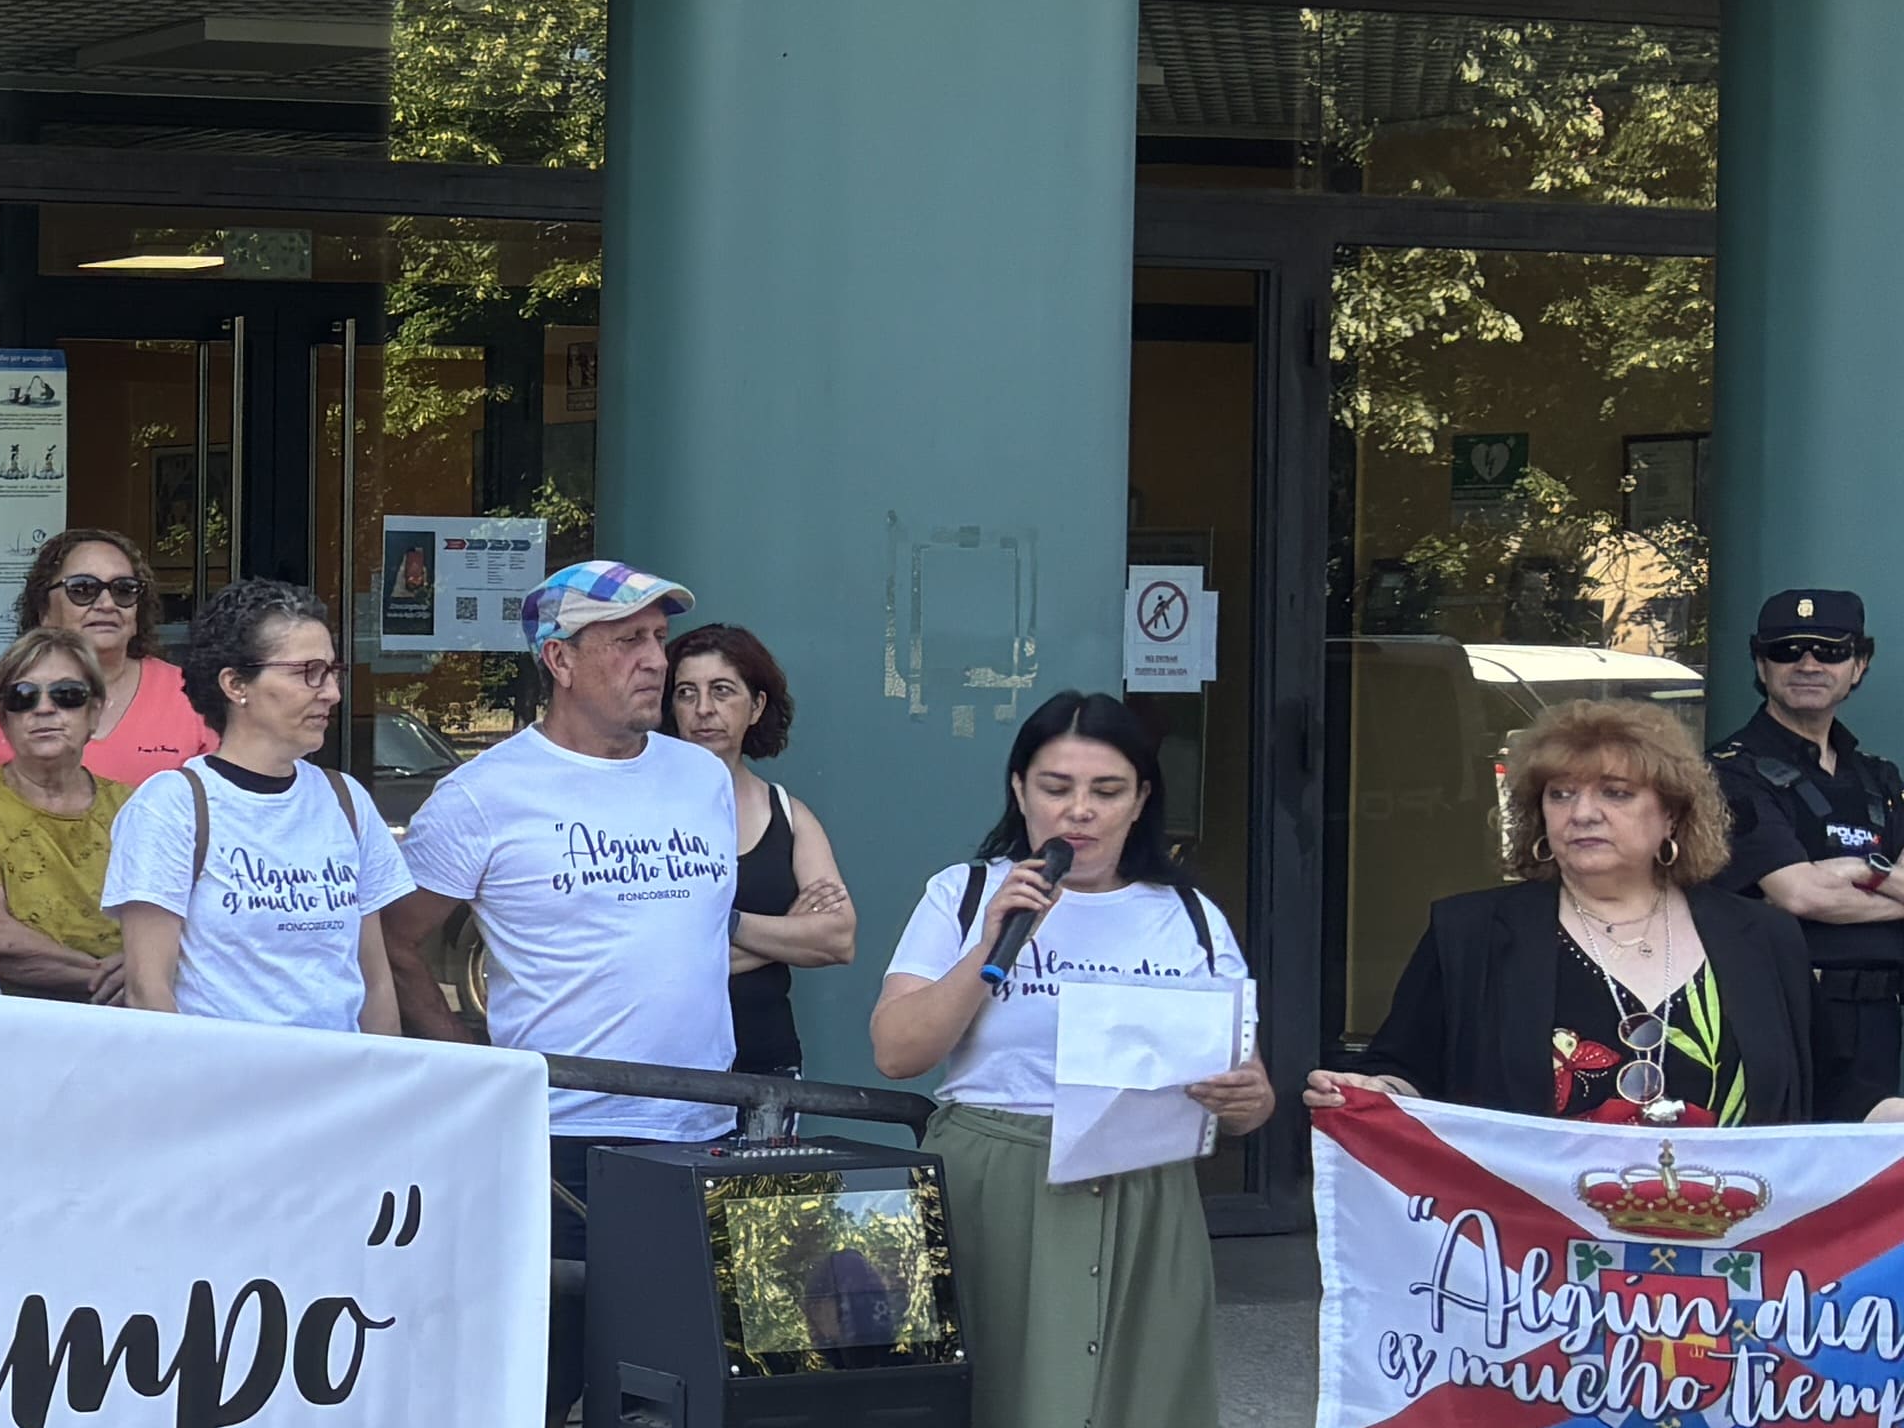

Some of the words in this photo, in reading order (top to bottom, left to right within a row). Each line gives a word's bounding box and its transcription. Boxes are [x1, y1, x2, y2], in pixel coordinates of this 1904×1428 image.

[552, 871, 576, 895] es
[581, 854, 663, 886] mucho
[554, 821, 662, 870] "Algún
[667, 827, 710, 857] día
[1407, 1194, 1735, 1351] "Algún
[1753, 1268, 1904, 1362] día
[1377, 1330, 1436, 1398] es
[1450, 1334, 1712, 1422] mucho
